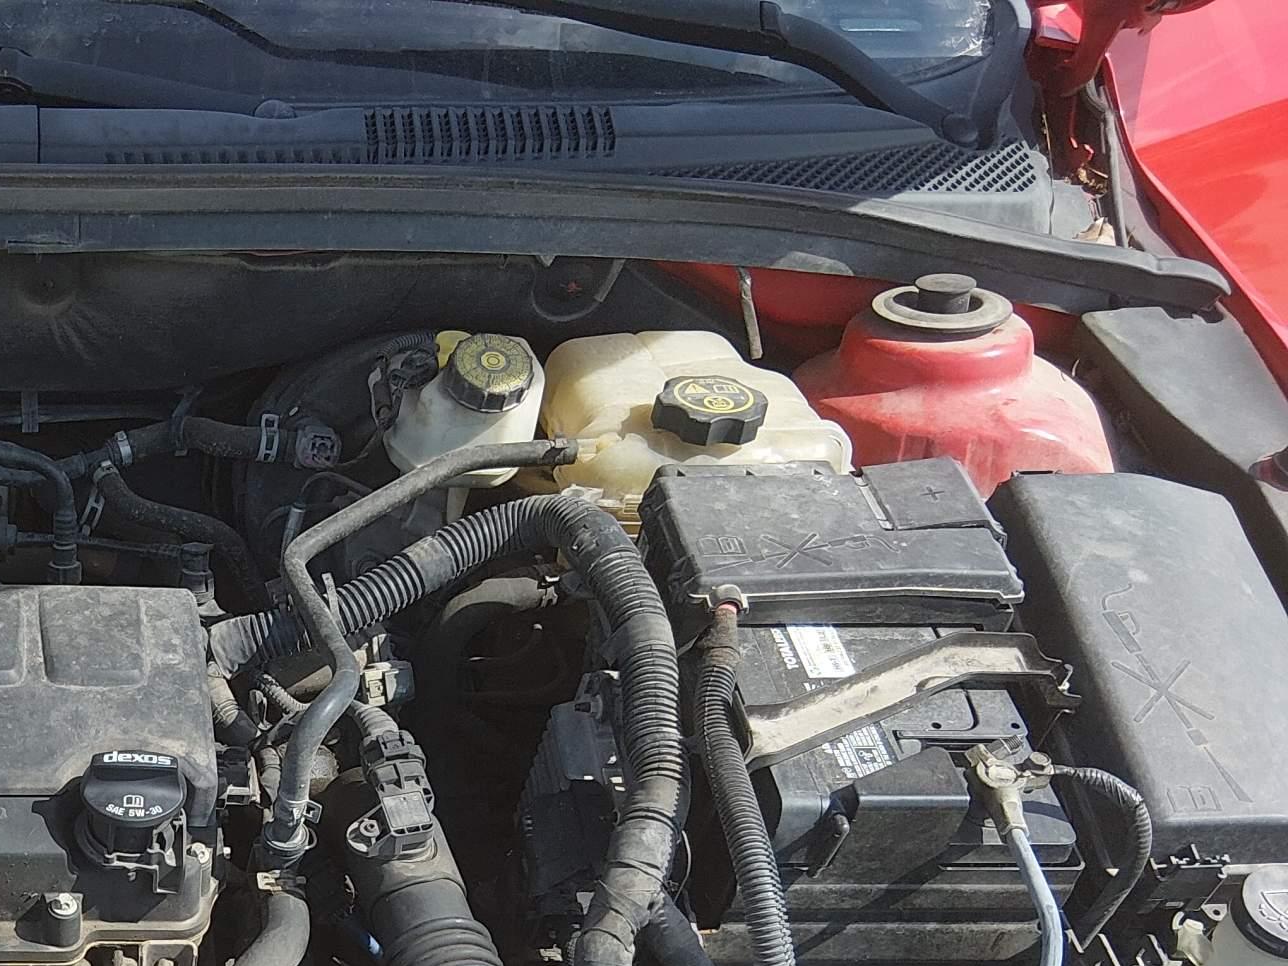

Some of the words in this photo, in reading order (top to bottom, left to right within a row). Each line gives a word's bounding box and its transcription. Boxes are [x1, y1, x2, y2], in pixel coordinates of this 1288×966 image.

[103, 751, 173, 766] dexos
[105, 804, 126, 817] SAE
[128, 805, 163, 818] 5W-30
